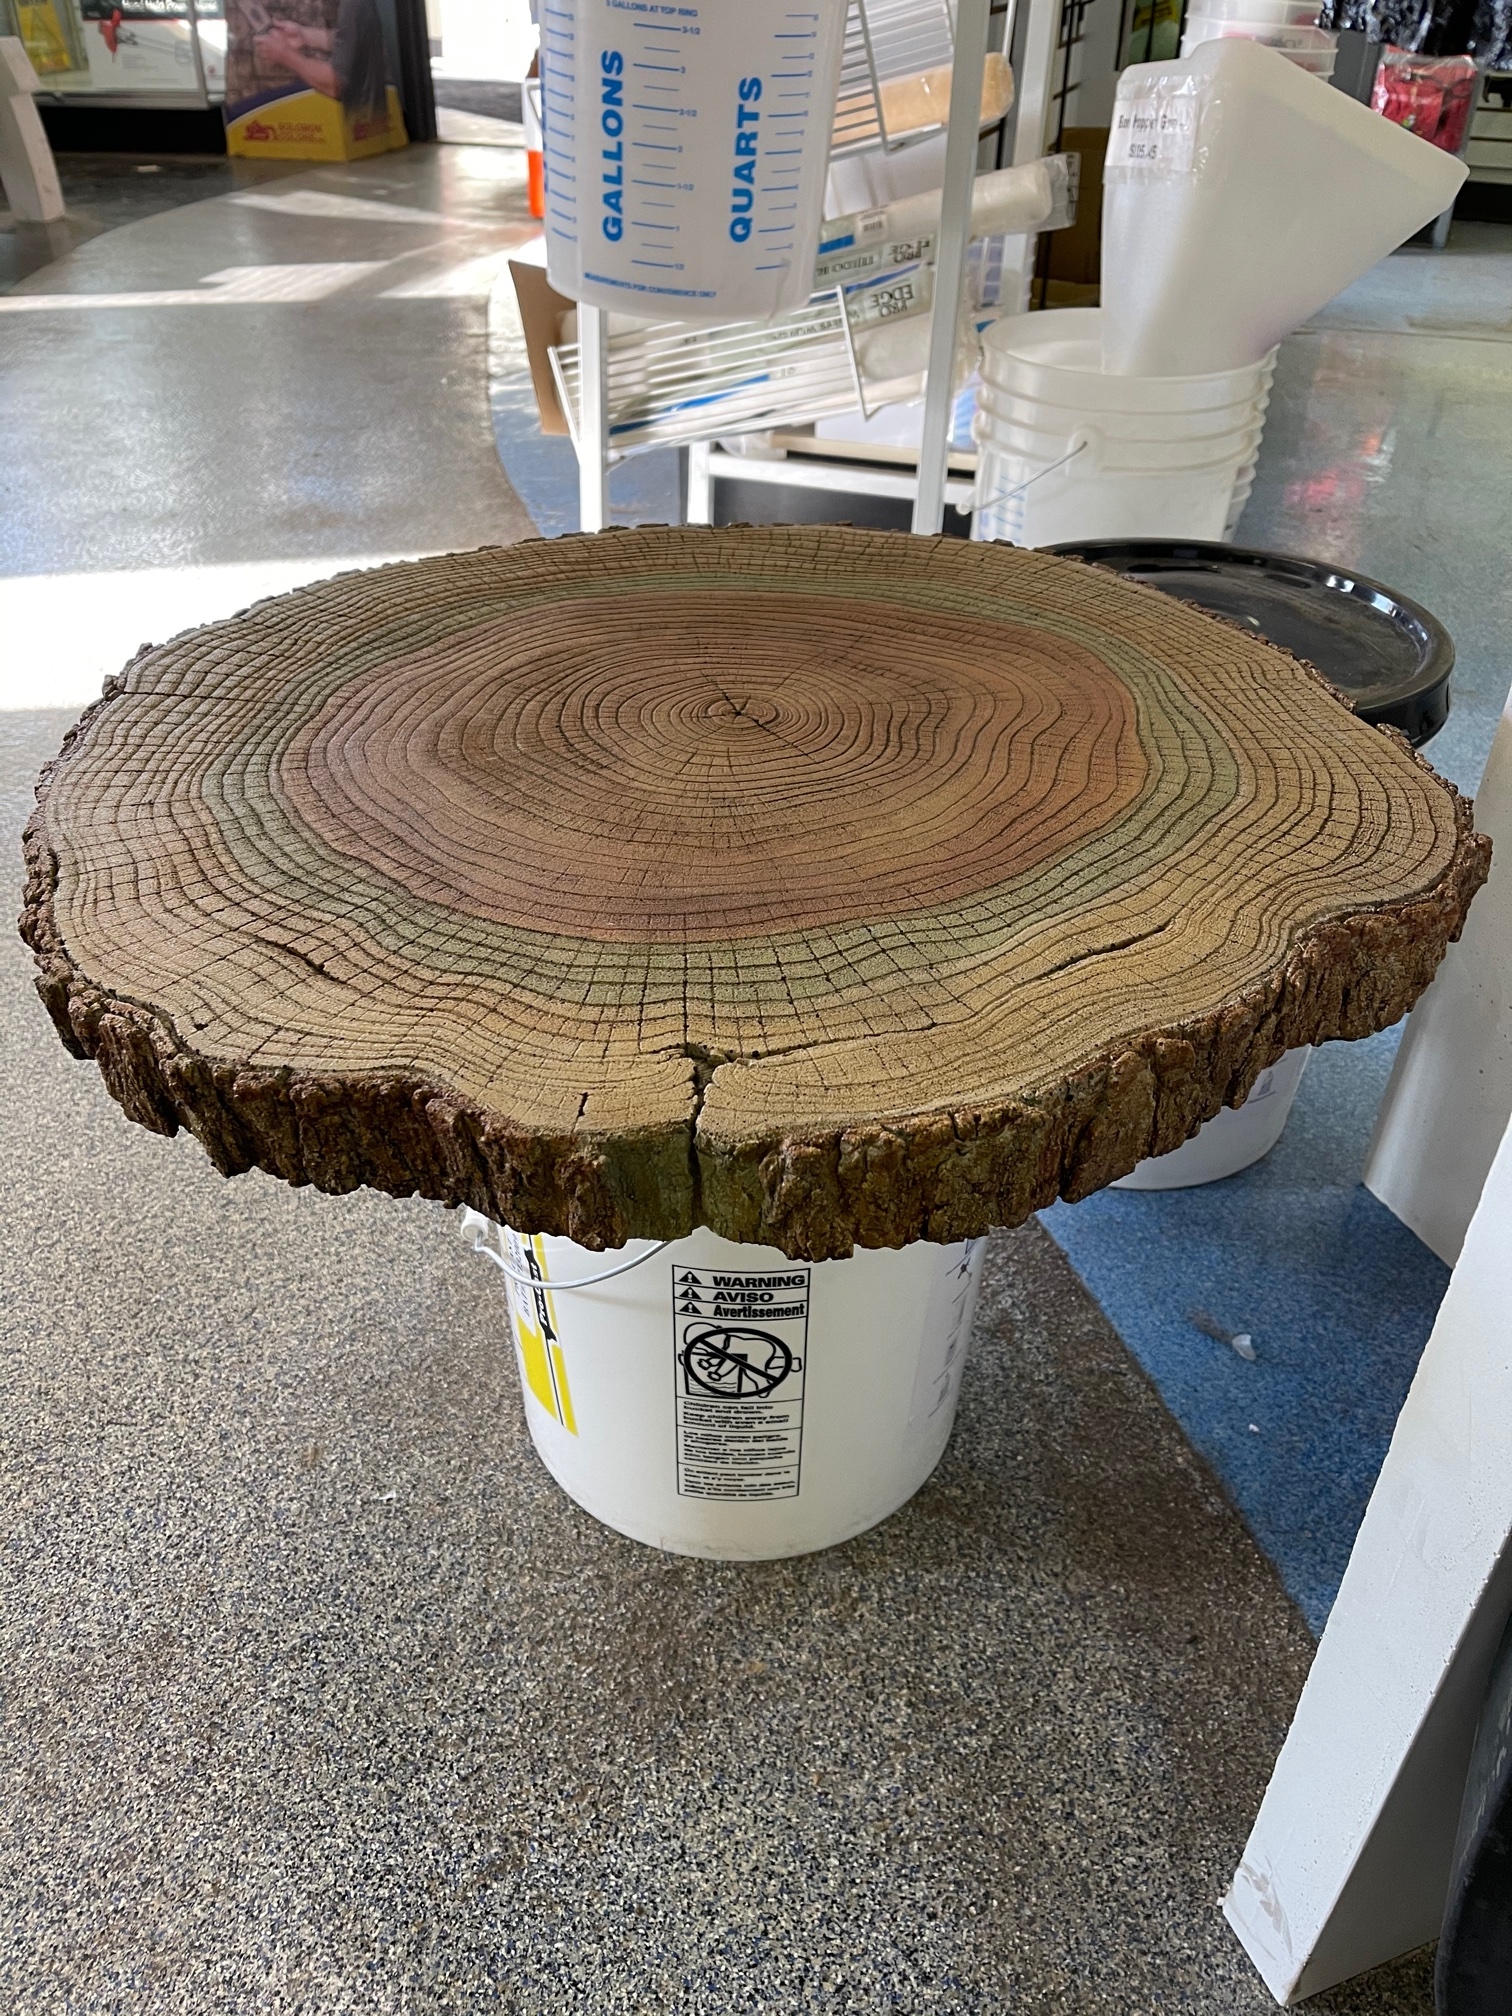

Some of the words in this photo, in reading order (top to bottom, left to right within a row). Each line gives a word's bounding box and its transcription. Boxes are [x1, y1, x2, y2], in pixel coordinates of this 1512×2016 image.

[649, 5, 659, 13] AT
[602, 49, 624, 242] GALLONS
[729, 76, 763, 243] QUARTS
[870, 284, 914, 308] EDGE
[880, 299, 908, 318] PRO
[712, 1275, 805, 1288] WARNING
[712, 1291, 774, 1302] AVISO
[713, 1303, 805, 1318] Avertissement
[684, 1401, 720, 1409] Children
